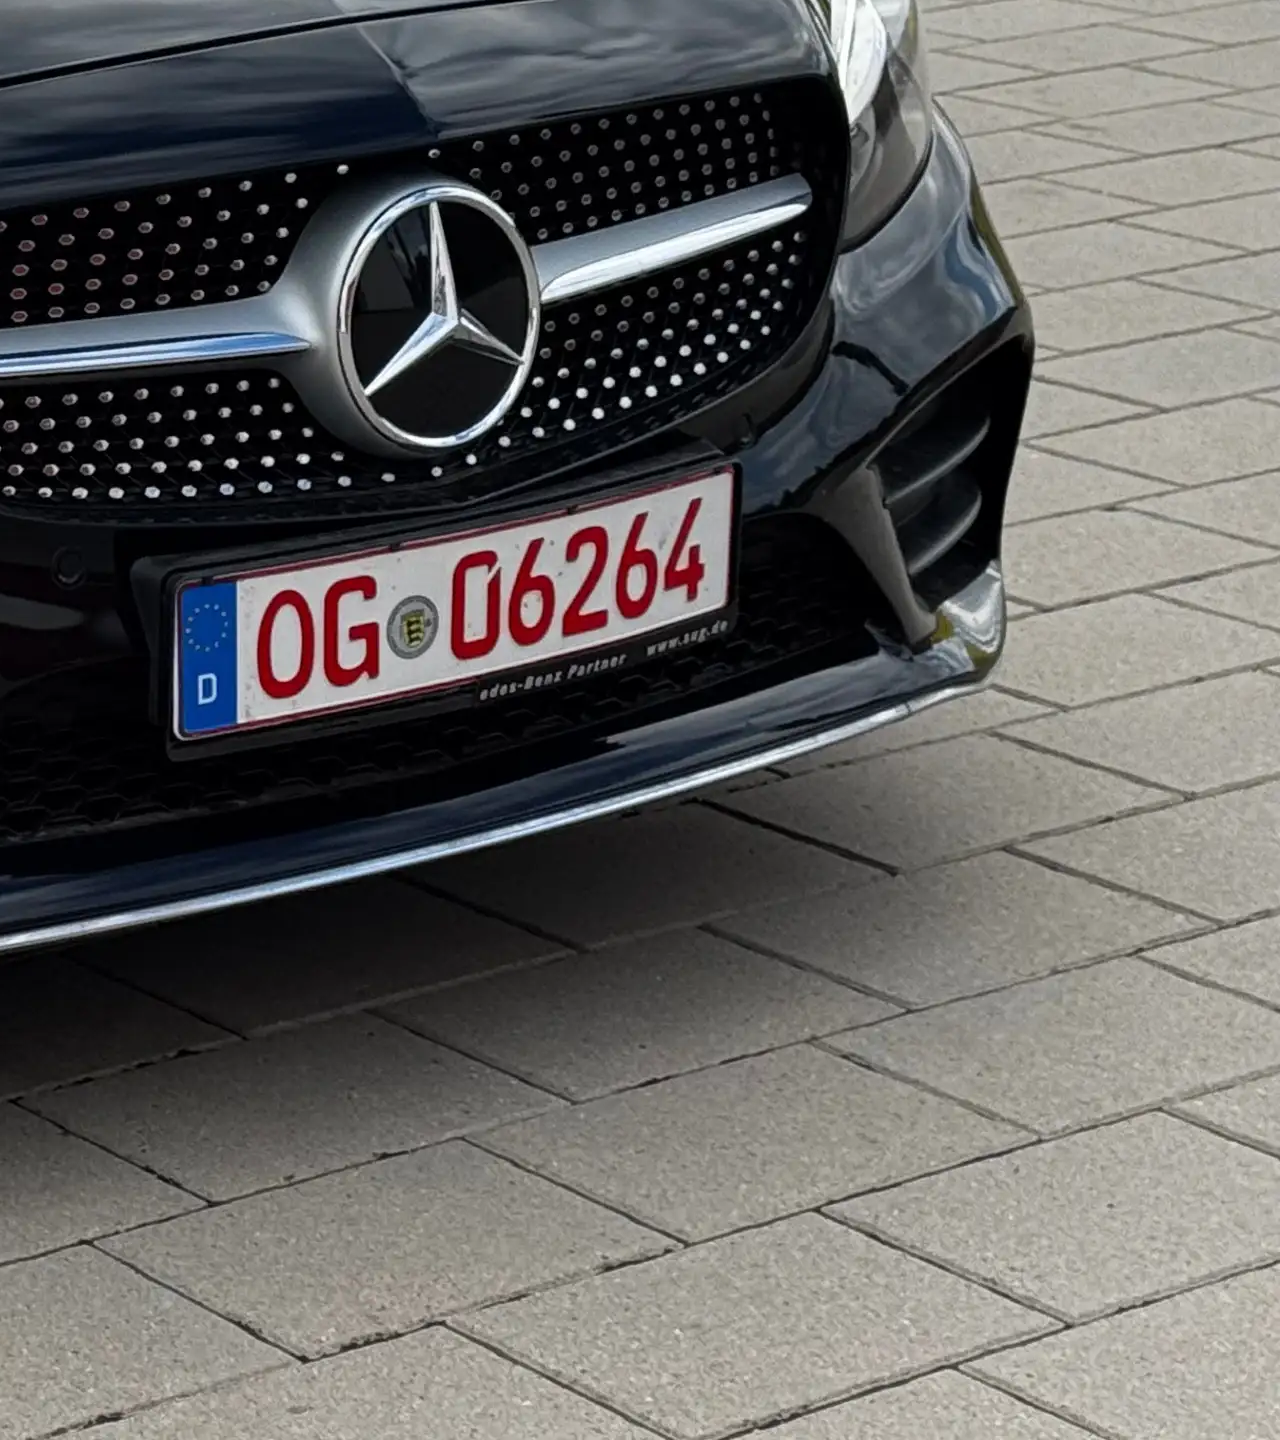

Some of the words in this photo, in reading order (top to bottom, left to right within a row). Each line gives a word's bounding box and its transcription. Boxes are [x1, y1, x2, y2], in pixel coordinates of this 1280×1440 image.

[257, 575, 380, 700] OG
[451, 497, 705, 661] 06264
[567, 653, 628, 680] Partner
[197, 672, 218, 706] D
